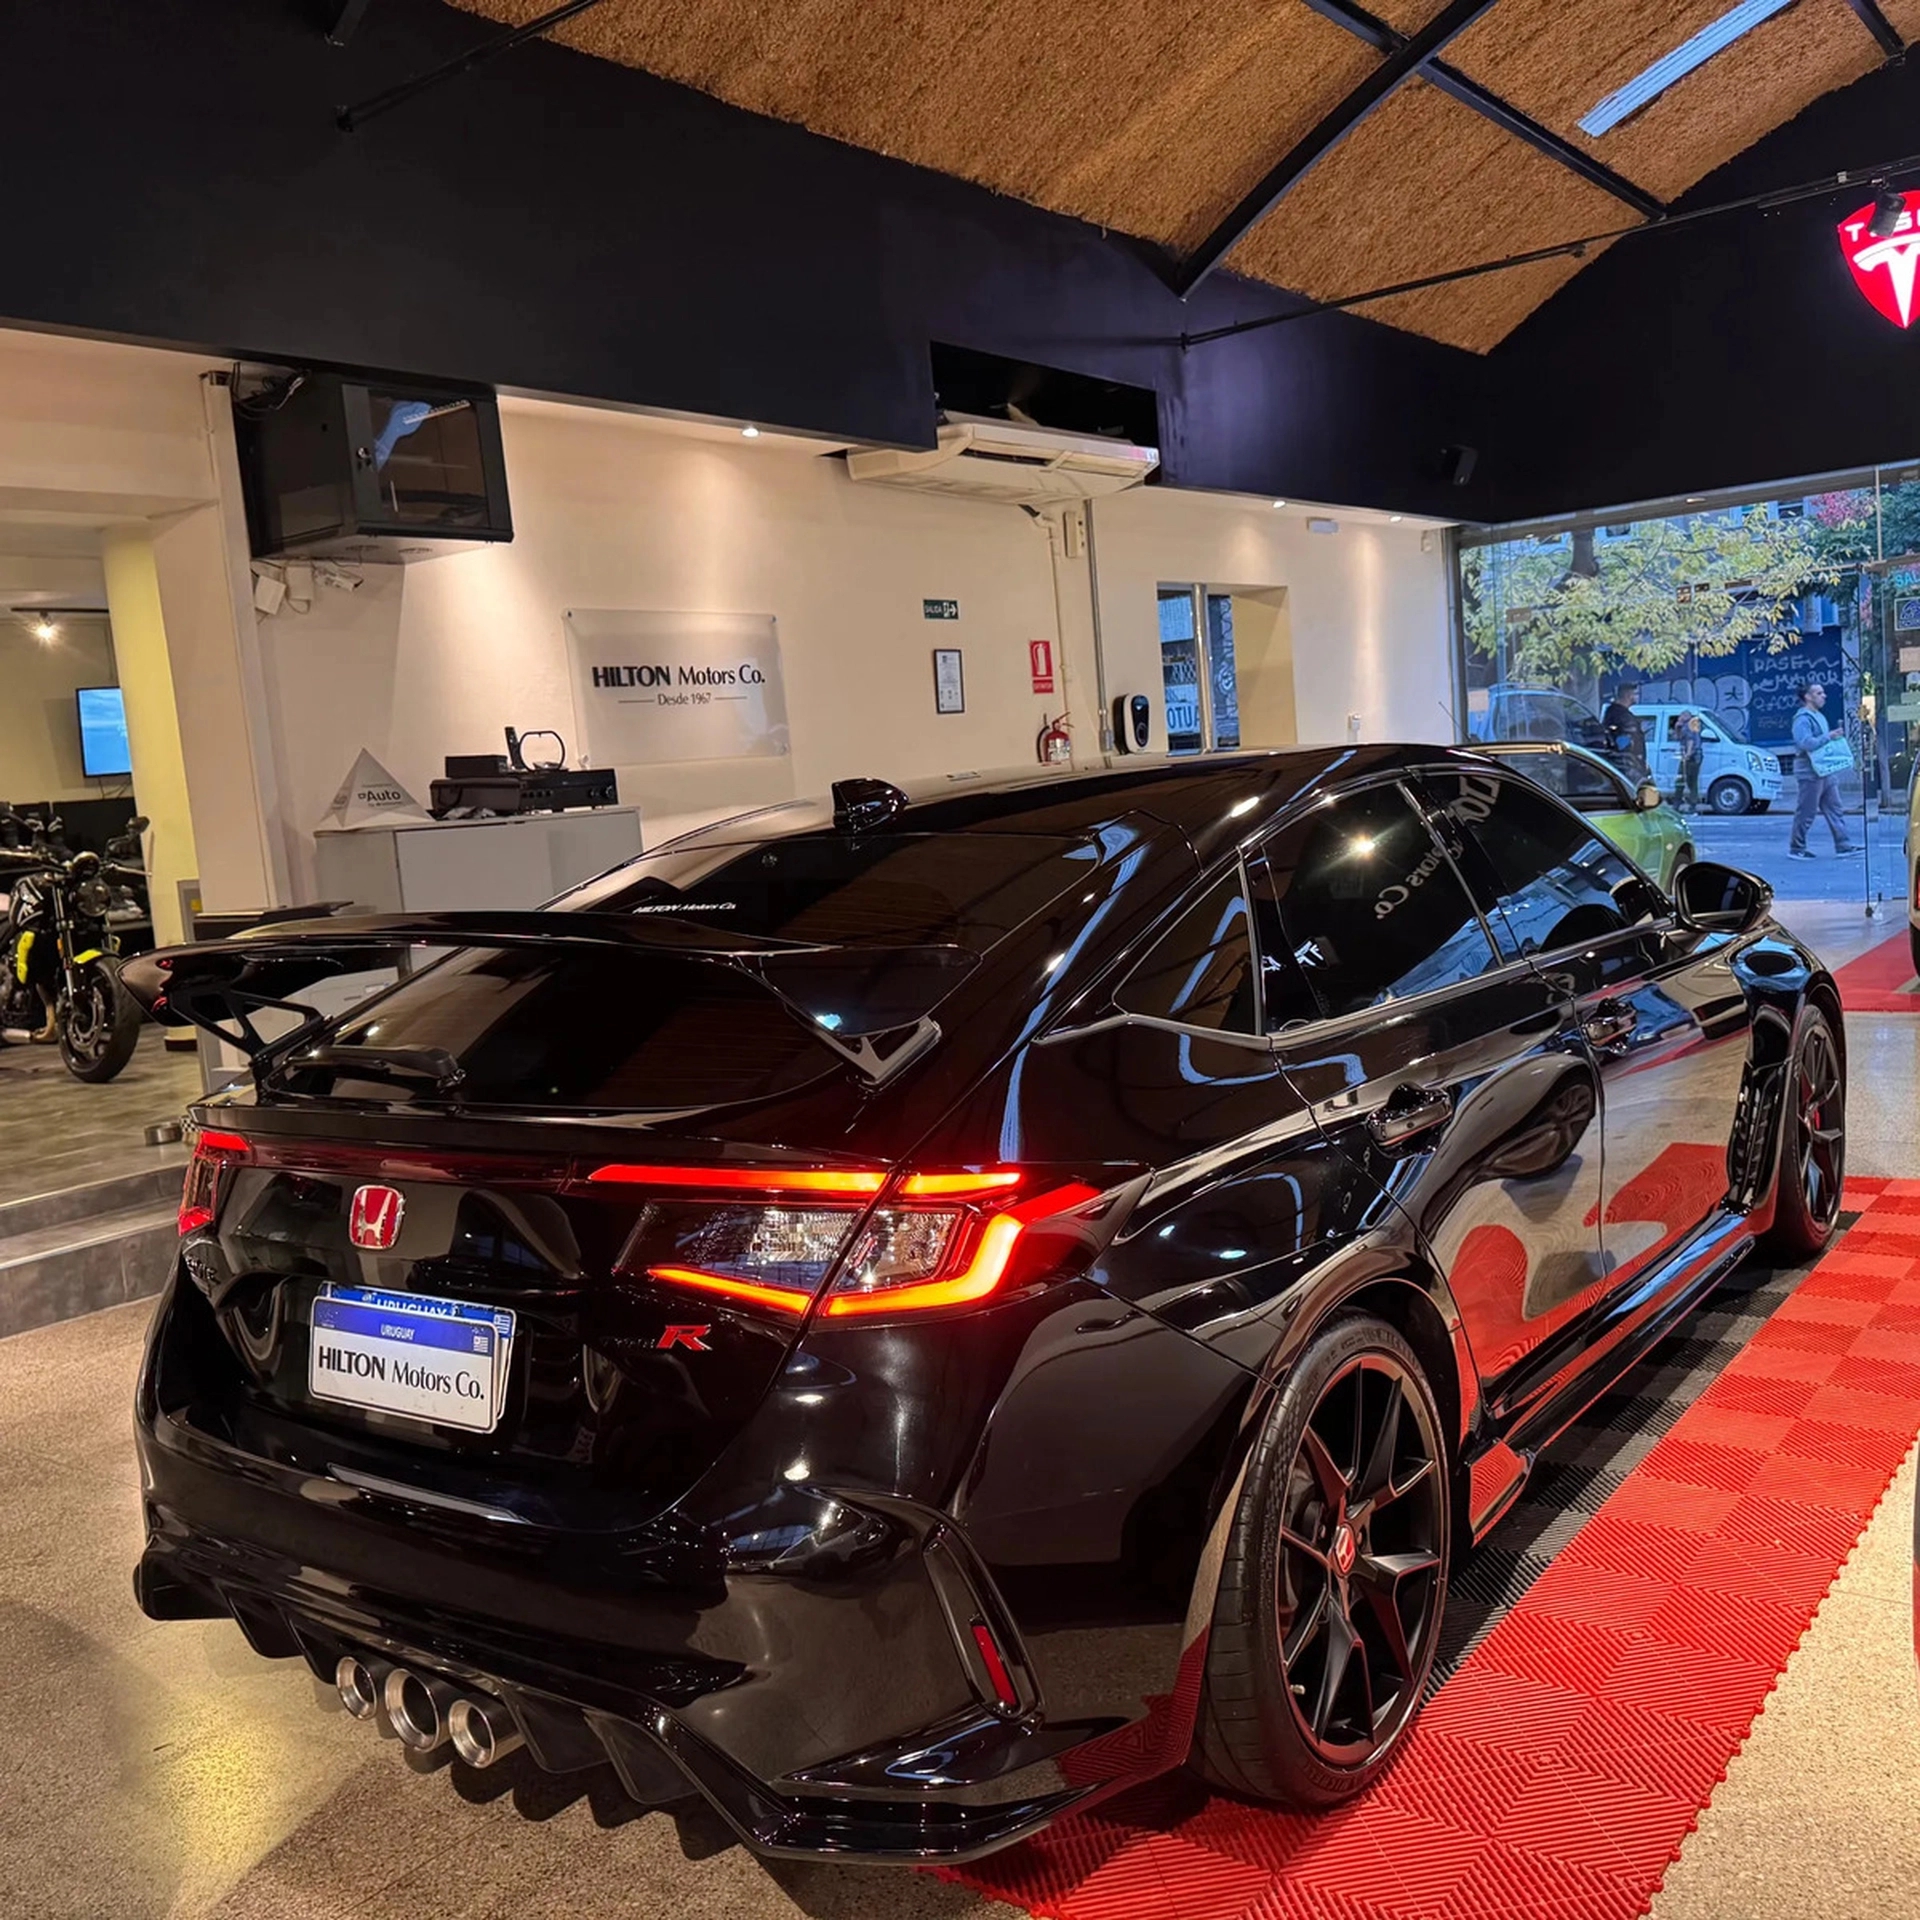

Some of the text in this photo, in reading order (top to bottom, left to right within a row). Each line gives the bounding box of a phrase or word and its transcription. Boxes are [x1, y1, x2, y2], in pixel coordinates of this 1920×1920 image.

[1845, 209, 1920, 242] TS
[592, 664, 766, 687] HILTON Motors Co.
[657, 692, 712, 706] Desde 1967
[380, 1323, 415, 1340] URUGUAY
[656, 1324, 713, 1351] R
[318, 1345, 485, 1400] HILTON Motors Co.
